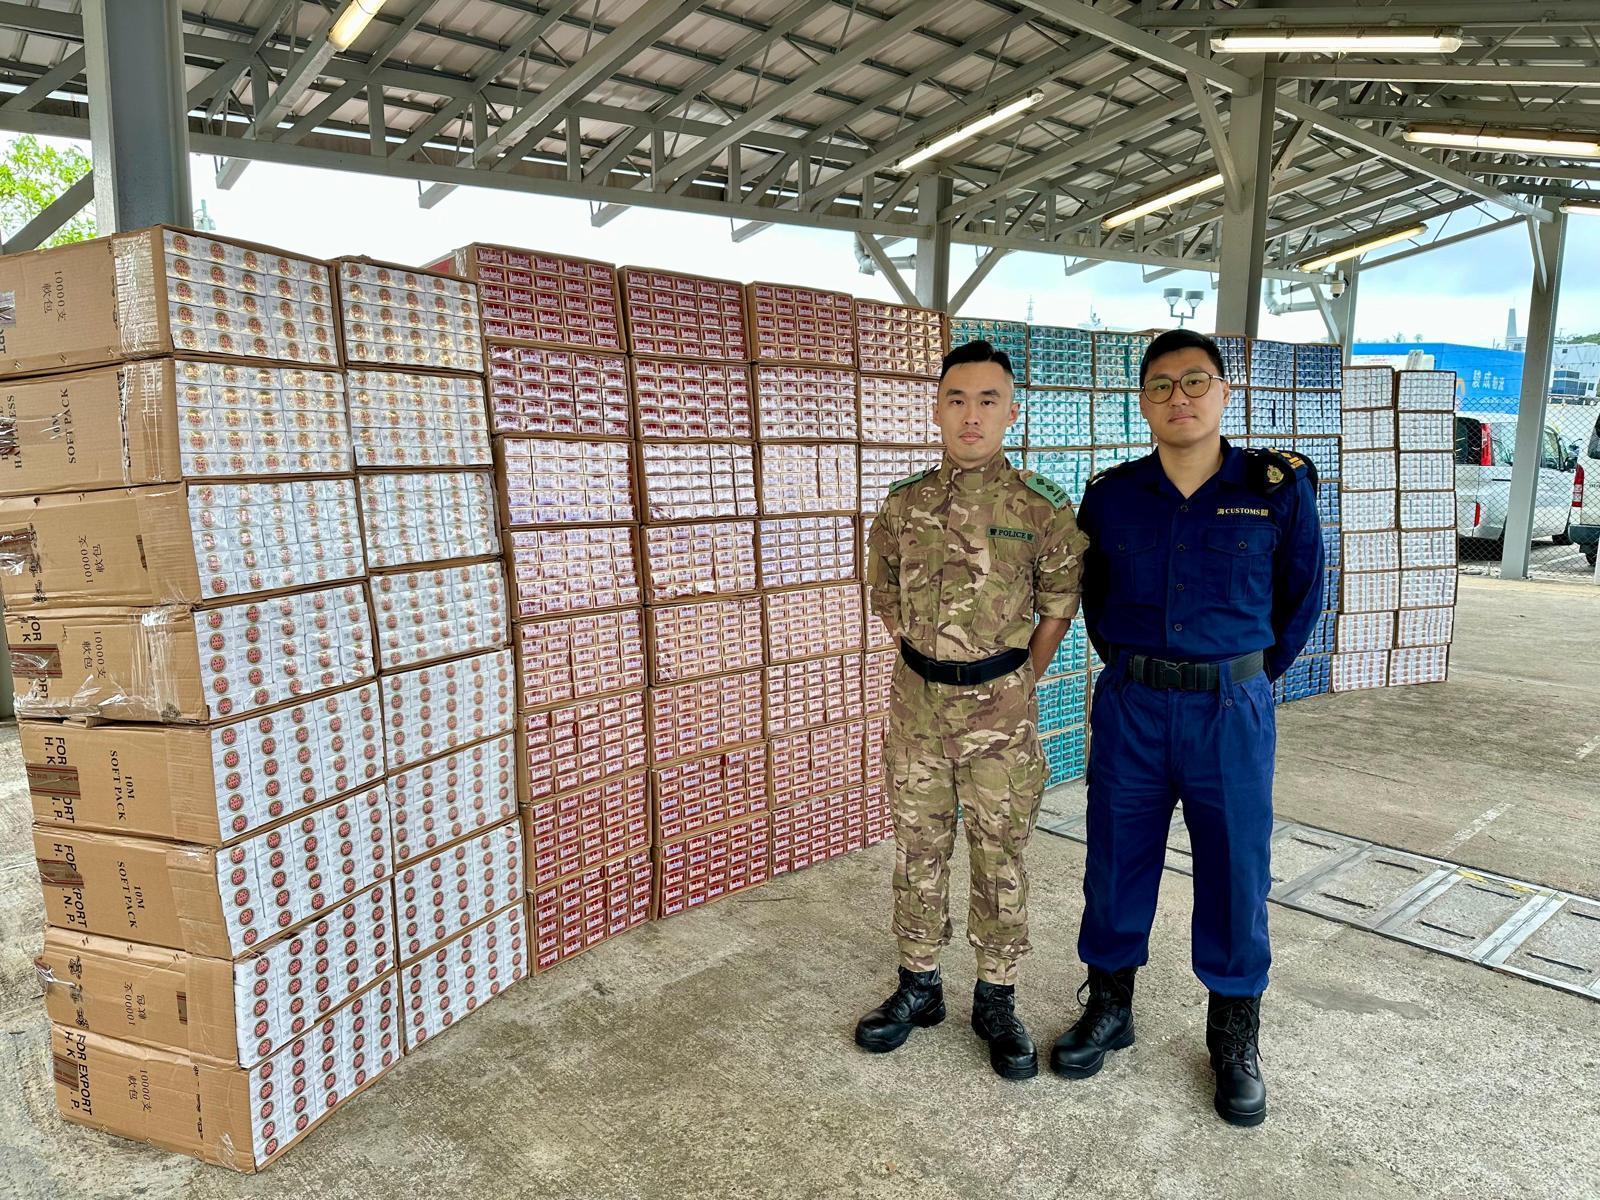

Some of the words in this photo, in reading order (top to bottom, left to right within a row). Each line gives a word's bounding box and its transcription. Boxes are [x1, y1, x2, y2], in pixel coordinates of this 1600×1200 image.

[55, 271, 66, 322] 10000支
[61, 388, 72, 425] PACK
[66, 429, 77, 464] SOFT
[1225, 507, 1261, 515] CUSTOMS
[998, 529, 1026, 539] POLICE
[79, 535, 93, 583] 10000支
[94, 631, 106, 678] 10000支
[44, 736, 54, 751] H.
[54, 809, 63, 821] P.
[56, 736, 67, 766] FOR
[62, 796, 75, 824] ORT
[110, 750, 121, 784] SOFT
[114, 786, 127, 821] PACK
[125, 775, 135, 799] 10M
[53, 843, 63, 857] H.
[118, 861, 131, 893] SOFT
[63, 895, 73, 909] N.
[124, 895, 138, 929] PACK
[134, 885, 145, 910] 10M
[66, 913, 76, 925] P.
[124, 981, 136, 1026] 10000支
[77, 1033, 87, 1061] FOR
[65, 1031, 74, 1044] H.
[71, 1098, 80, 1110] P.
[78, 1063, 92, 1116] EXPORT
[140, 1069, 152, 1112] 10000支
